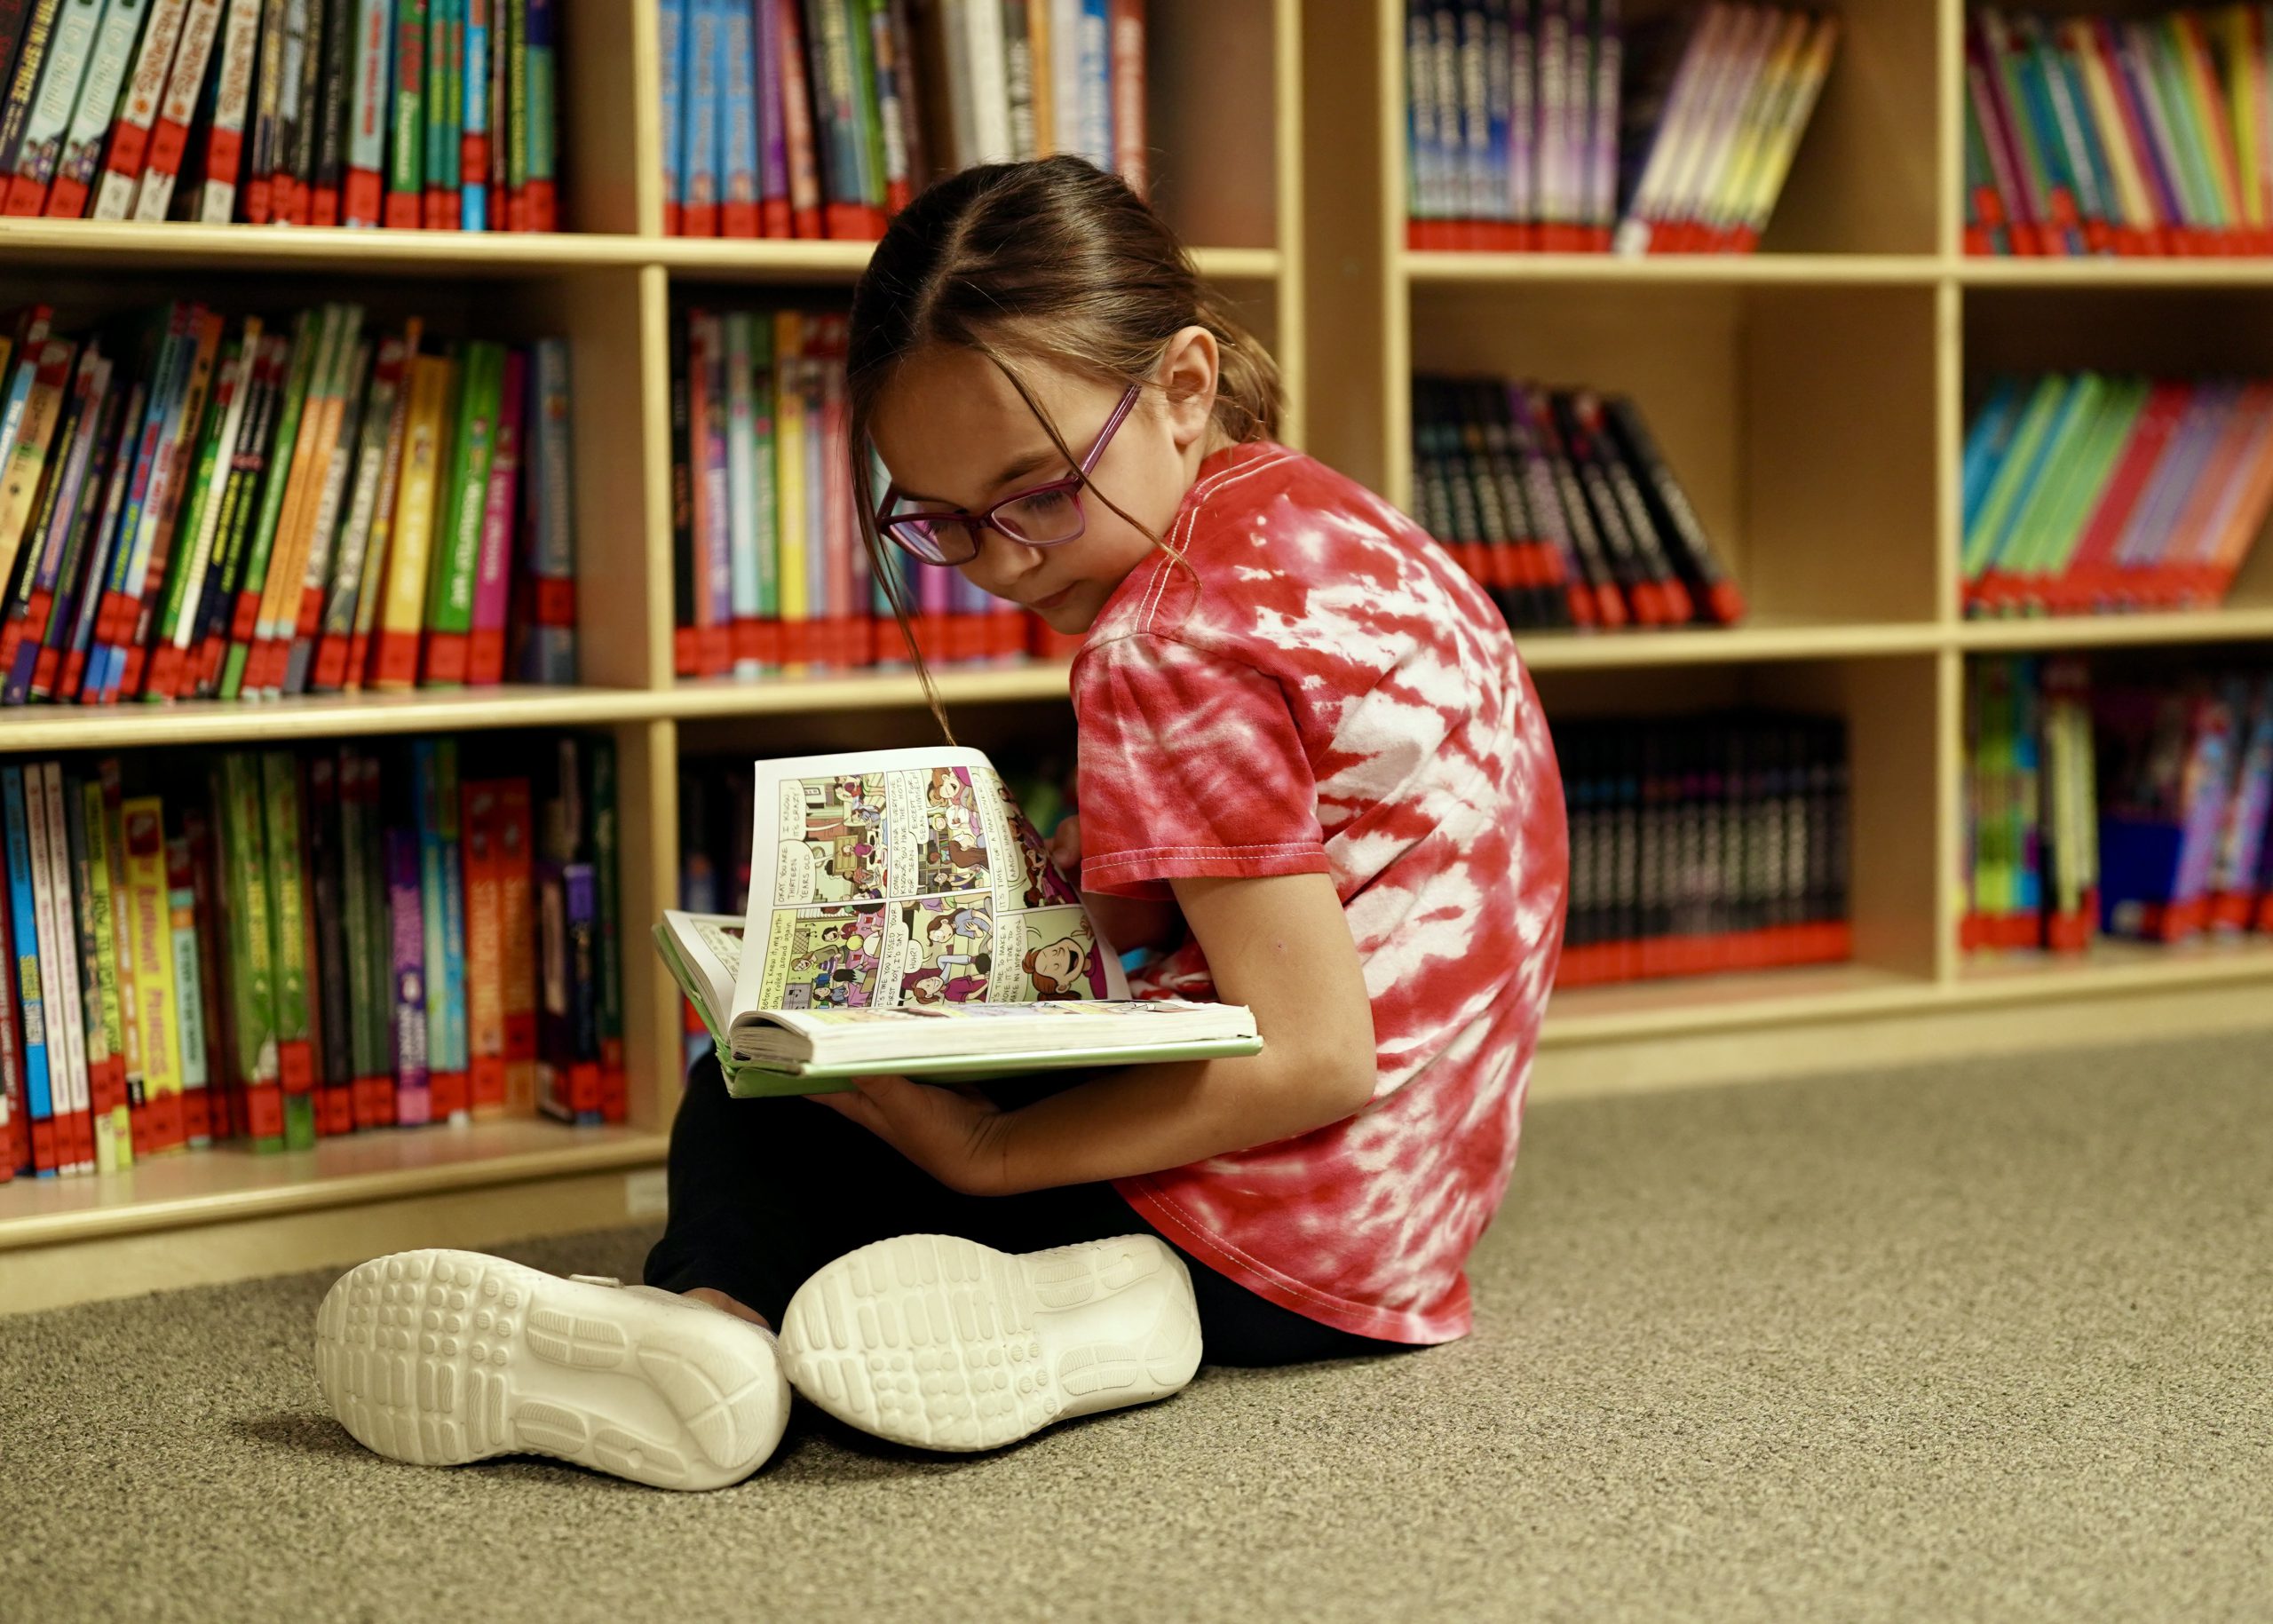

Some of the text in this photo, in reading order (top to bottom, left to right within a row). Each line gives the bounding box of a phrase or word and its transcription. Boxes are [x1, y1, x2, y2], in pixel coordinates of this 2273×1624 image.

[890, 780, 899, 823] EVERYONE
[909, 800, 918, 829] EXCEPT
[788, 858, 797, 899] THIRTEEN
[800, 874, 809, 900] YEARS
[995, 868, 1004, 889] TIME
[889, 909, 898, 929] YOUR
[887, 932, 896, 958] KISSED
[1008, 931, 1014, 941] TO
[760, 986, 772, 1010] Before
[773, 936, 782, 947] my
[995, 970, 1004, 990] TIME
[1013, 973, 1020, 982] AN
[771, 995, 782, 1010] day
[886, 987, 896, 1006] FIRST
[991, 992, 1000, 1002] T'S
